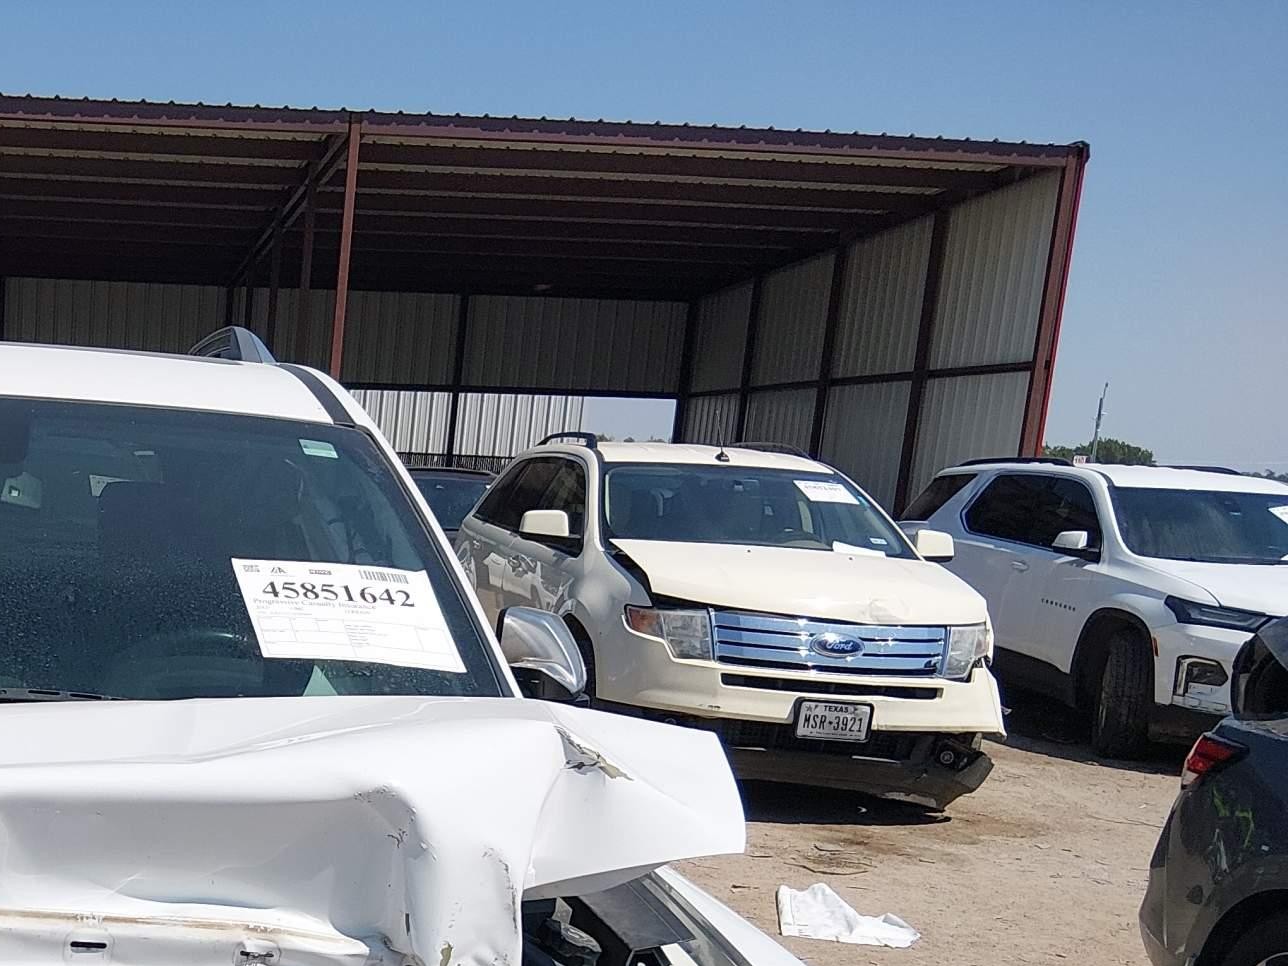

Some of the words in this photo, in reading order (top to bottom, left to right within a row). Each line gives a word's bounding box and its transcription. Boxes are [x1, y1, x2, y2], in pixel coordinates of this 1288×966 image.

[262, 580, 415, 607] 45851642
[825, 637, 854, 652] Ford
[823, 704, 849, 713] TEXAS
